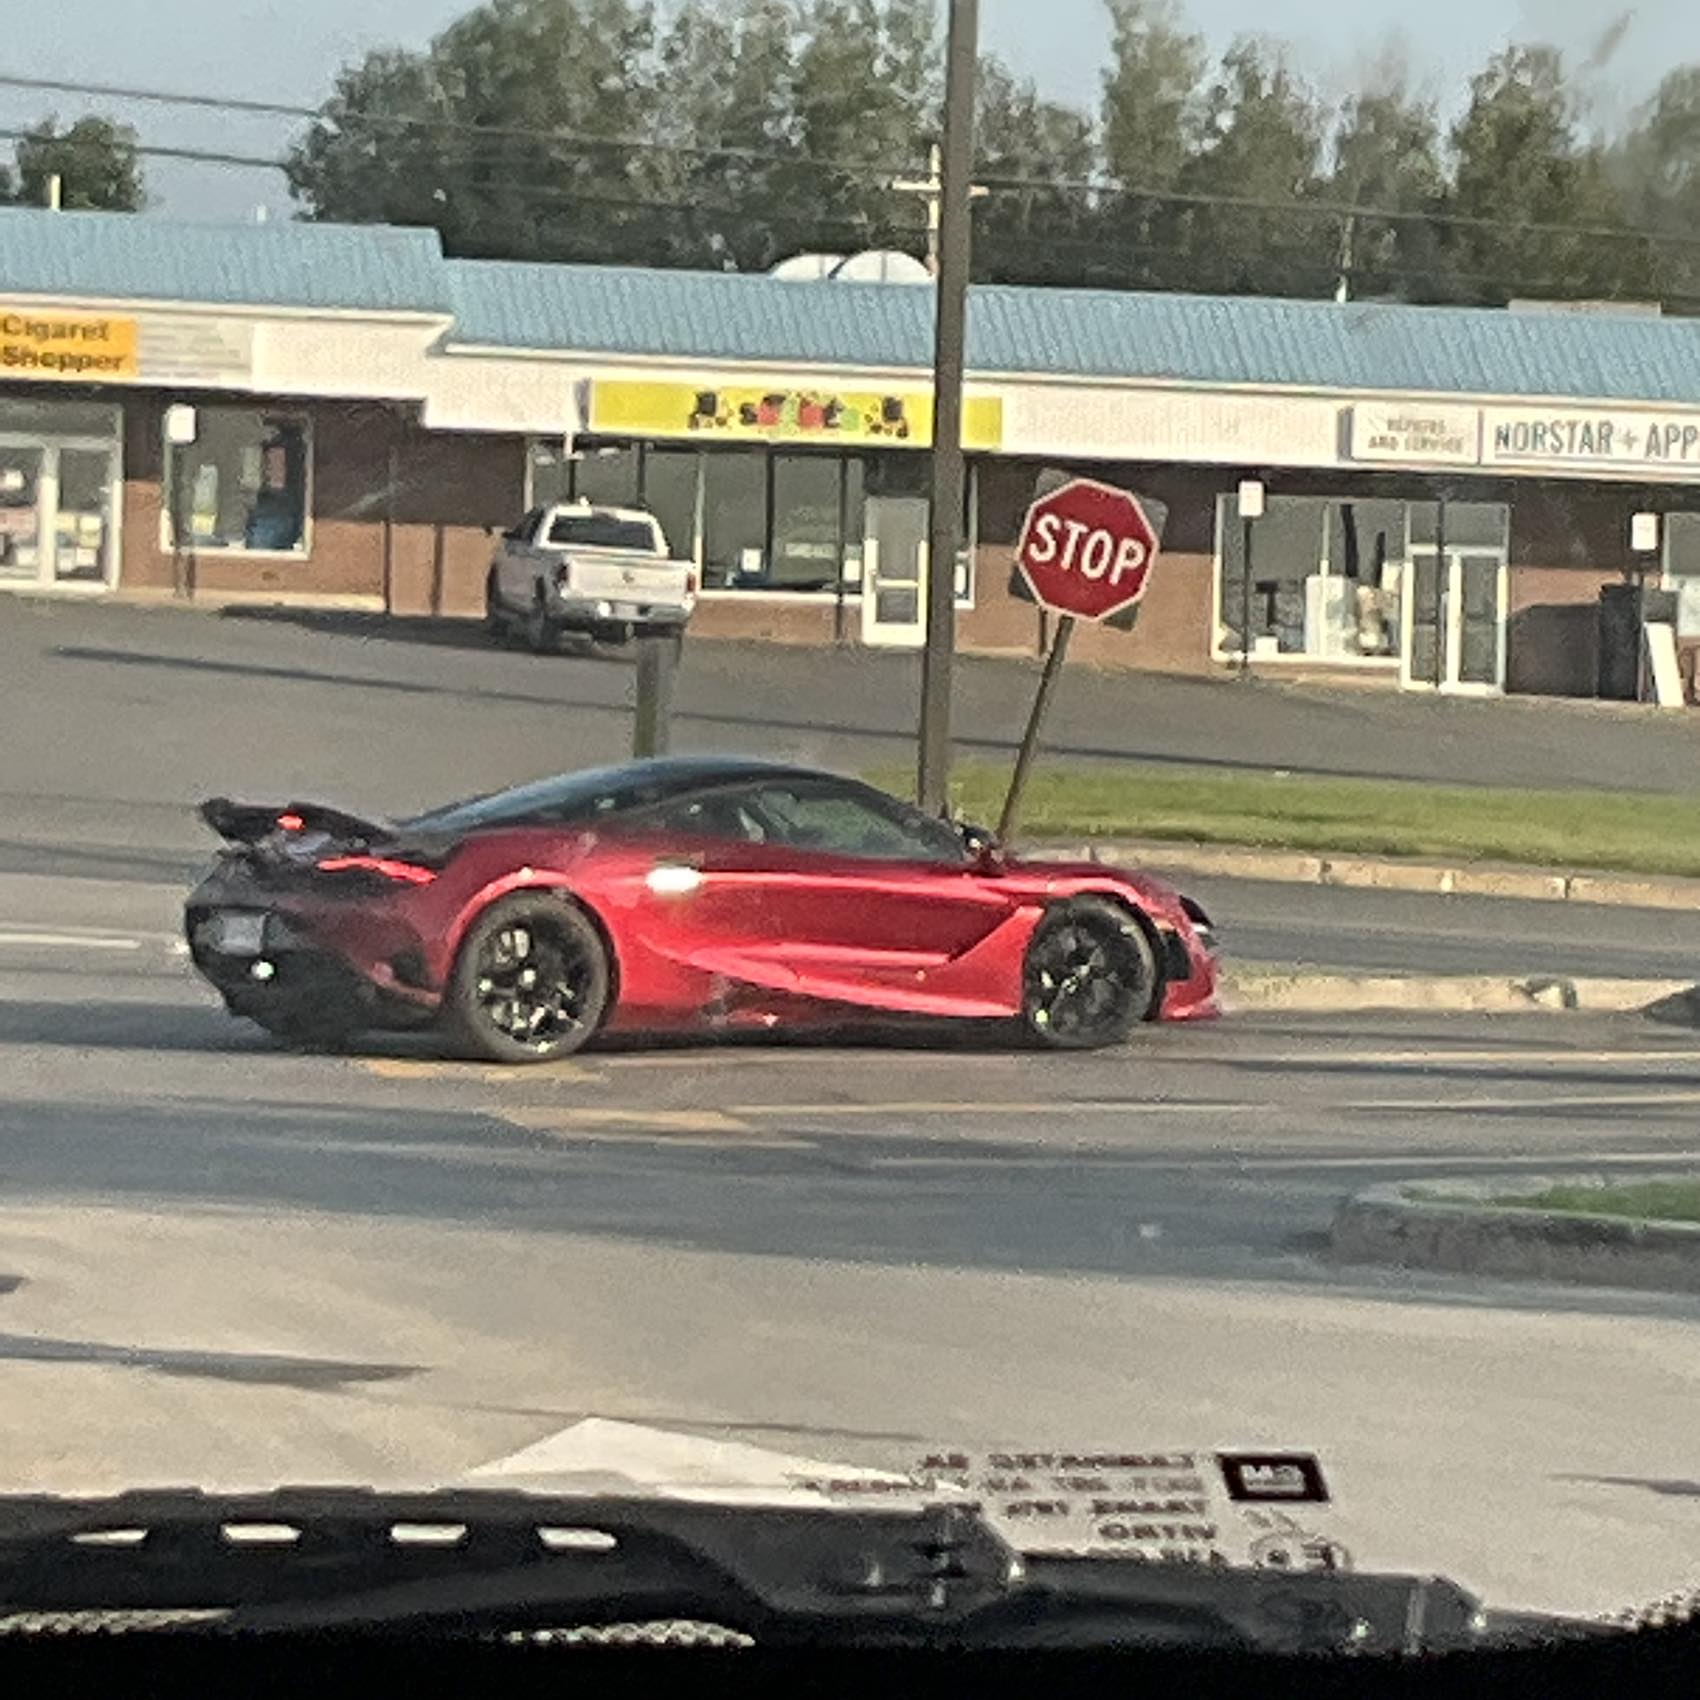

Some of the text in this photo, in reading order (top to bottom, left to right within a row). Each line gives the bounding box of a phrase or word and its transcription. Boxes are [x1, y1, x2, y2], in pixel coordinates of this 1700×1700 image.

[2, 314, 110, 343] Cigaret
[2, 345, 127, 373] Shopper
[1495, 420, 1614, 455] NORSTAR
[1029, 513, 1146, 586] STOP
